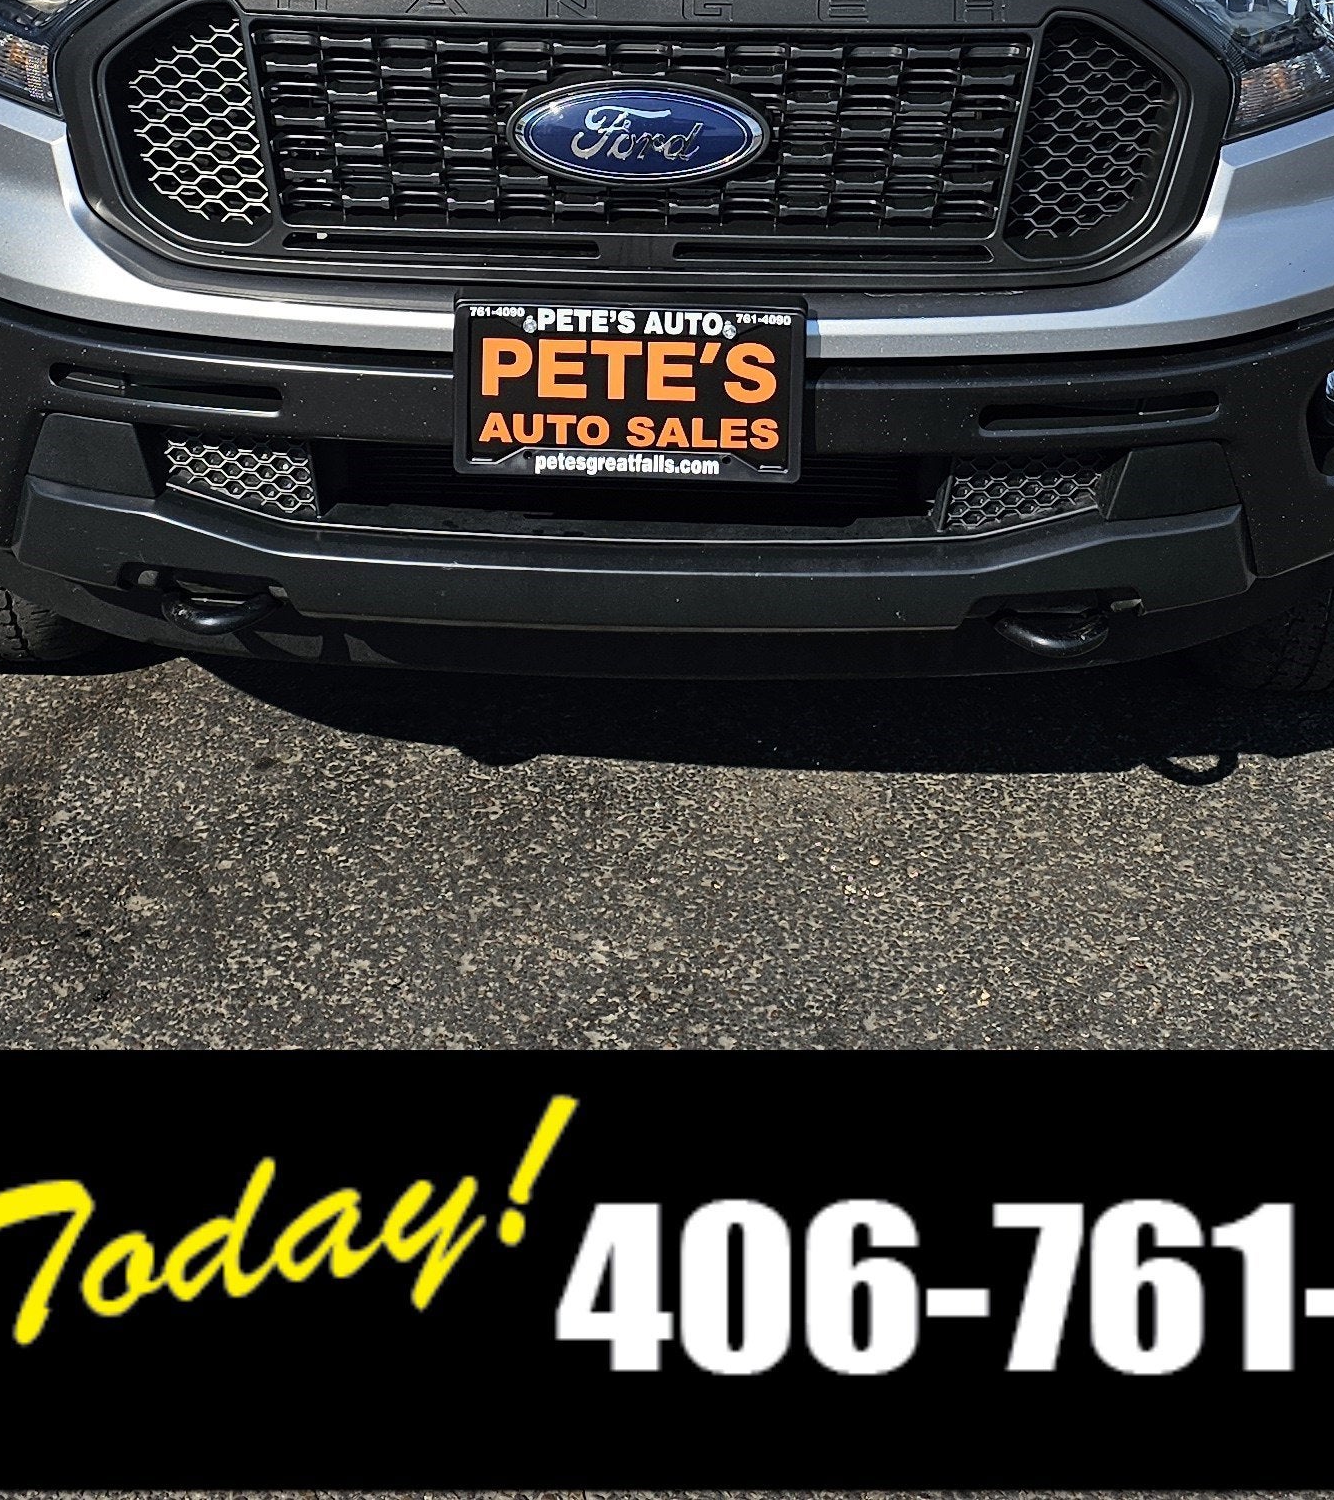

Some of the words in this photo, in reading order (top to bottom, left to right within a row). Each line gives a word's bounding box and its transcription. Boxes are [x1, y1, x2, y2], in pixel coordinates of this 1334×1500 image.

[570, 105, 704, 161] Ford
[469, 306, 526, 317] 761-4090
[537, 307, 636, 334] PETE'S
[643, 311, 725, 336] AUTO
[735, 313, 792, 326] 761-4090
[481, 337, 777, 404] PETE'S
[479, 412, 610, 446] AUTO
[626, 416, 779, 450] SALES
[534, 452, 720, 476] petesgreatfalls.com
